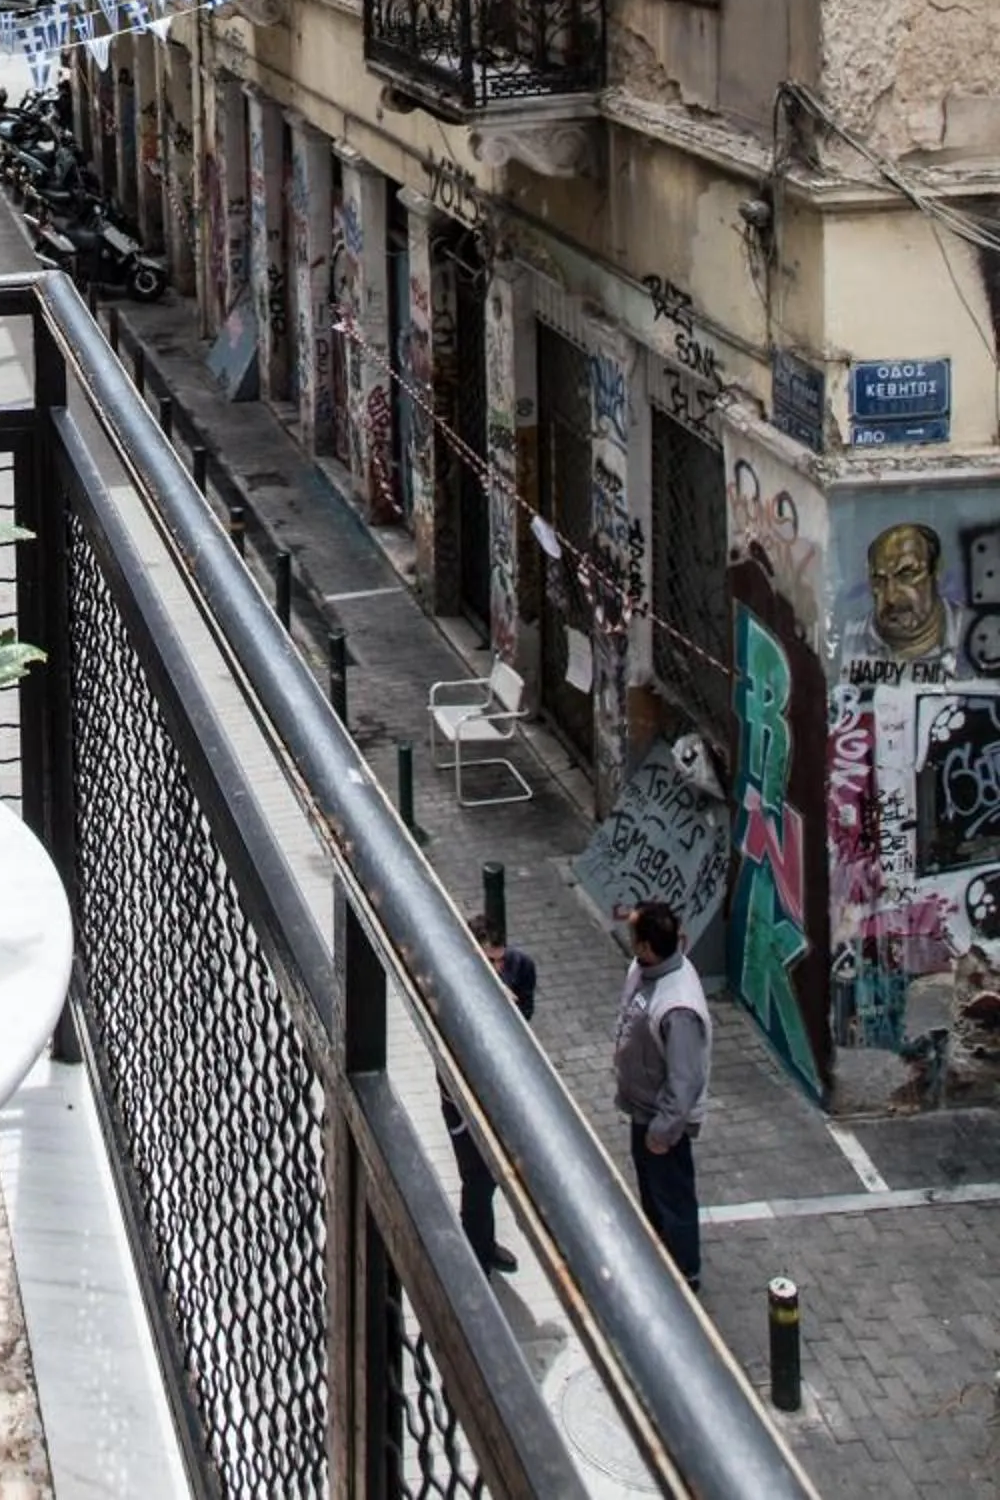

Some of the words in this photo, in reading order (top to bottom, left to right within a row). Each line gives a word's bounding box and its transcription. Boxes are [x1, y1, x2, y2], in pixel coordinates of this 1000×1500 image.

[877, 363, 926, 379] ΟΔΟΣ
[865, 380, 937, 398] ΚΕΒΗΤΟΣ
[856, 430, 885, 444] ΑΠΟ
[849, 659, 906, 685] HAPPY
